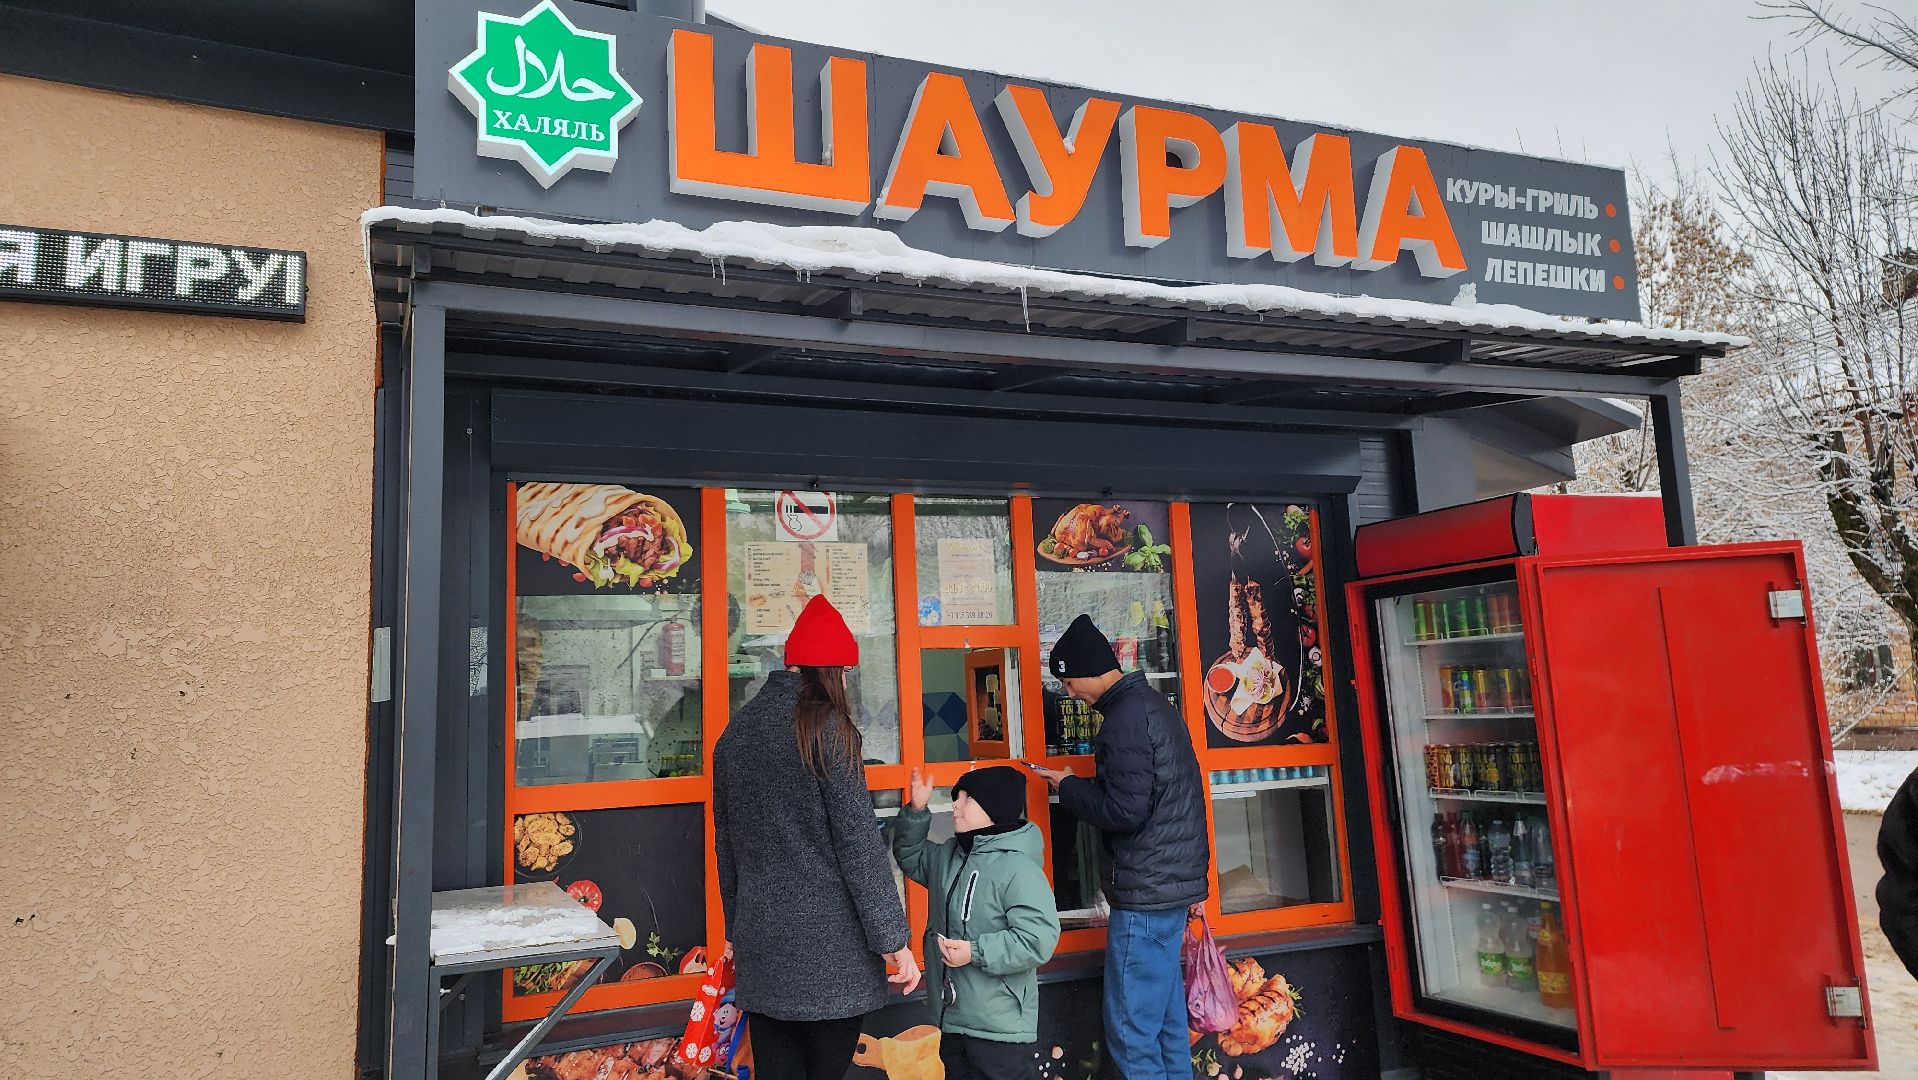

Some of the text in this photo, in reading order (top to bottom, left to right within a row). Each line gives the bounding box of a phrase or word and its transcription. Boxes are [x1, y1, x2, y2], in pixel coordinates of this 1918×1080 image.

[486, 35, 616, 101] حلال
[492, 109, 606, 142] ХАЛЯЛЬ
[668, 28, 1468, 276] ШАУРМА
[1446, 177, 1599, 220] КУРЫ-ГРИЛЬ
[1481, 220, 1602, 257] ШАШЛЫК
[1484, 257, 1606, 293] ЛЕПЕШКИ
